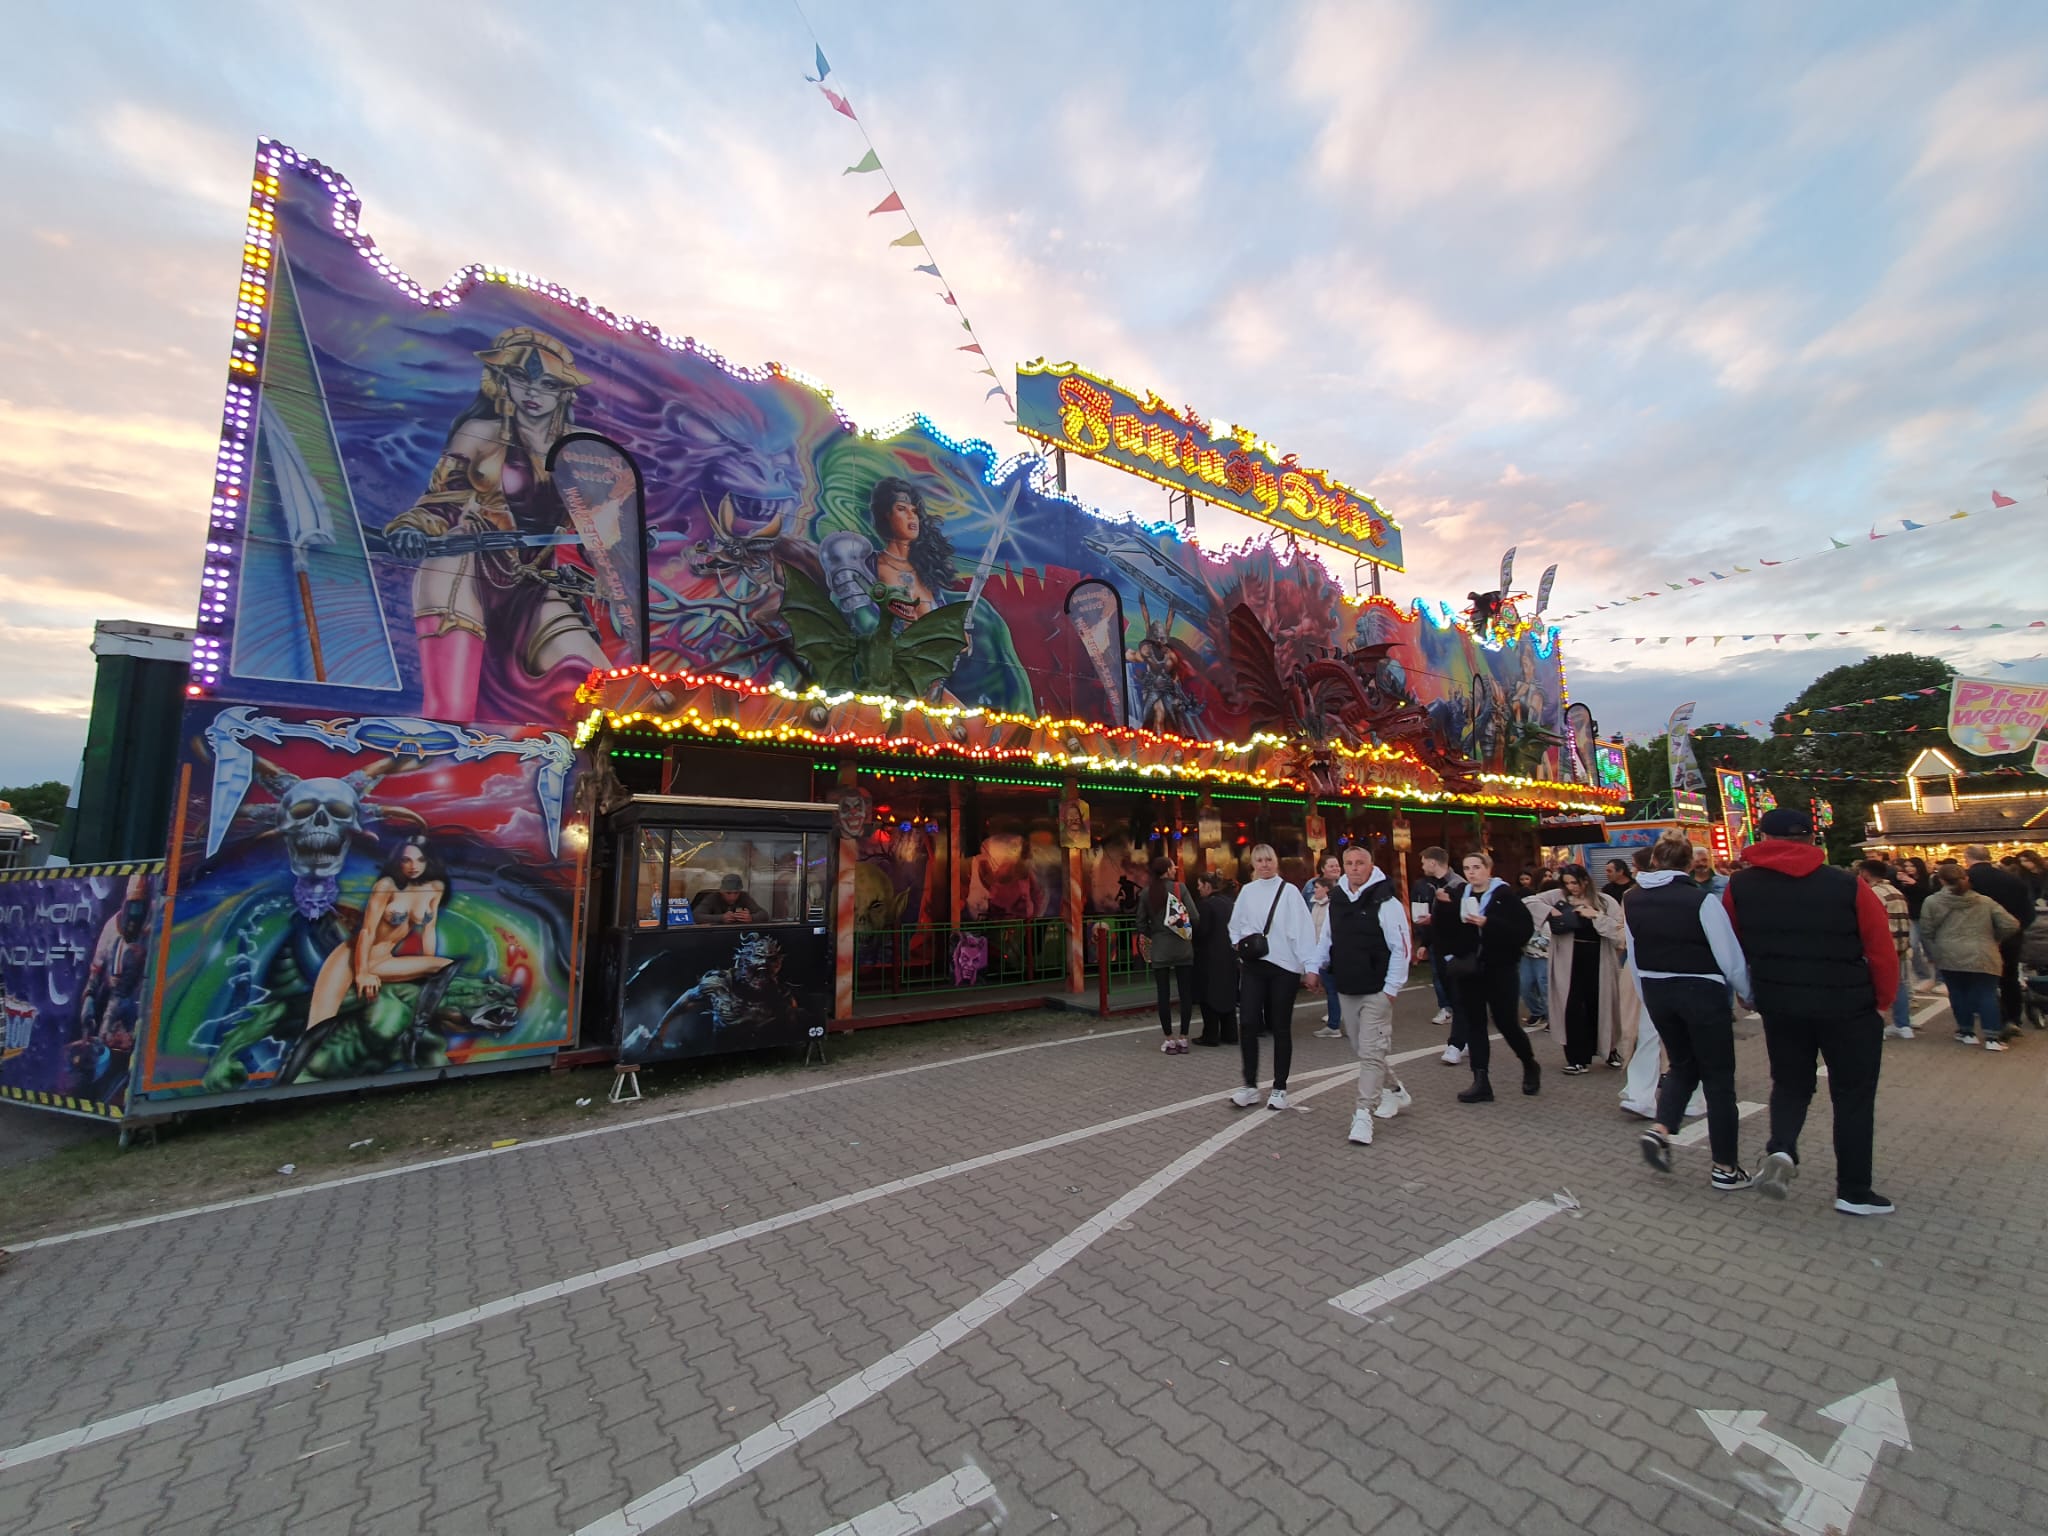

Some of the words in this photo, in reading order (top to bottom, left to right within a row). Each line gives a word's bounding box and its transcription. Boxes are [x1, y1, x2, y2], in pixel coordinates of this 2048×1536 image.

[1279, 470, 1387, 549] Drive
[1956, 683, 2048, 707] Pfeil
[1952, 708, 2041, 728] werfen
